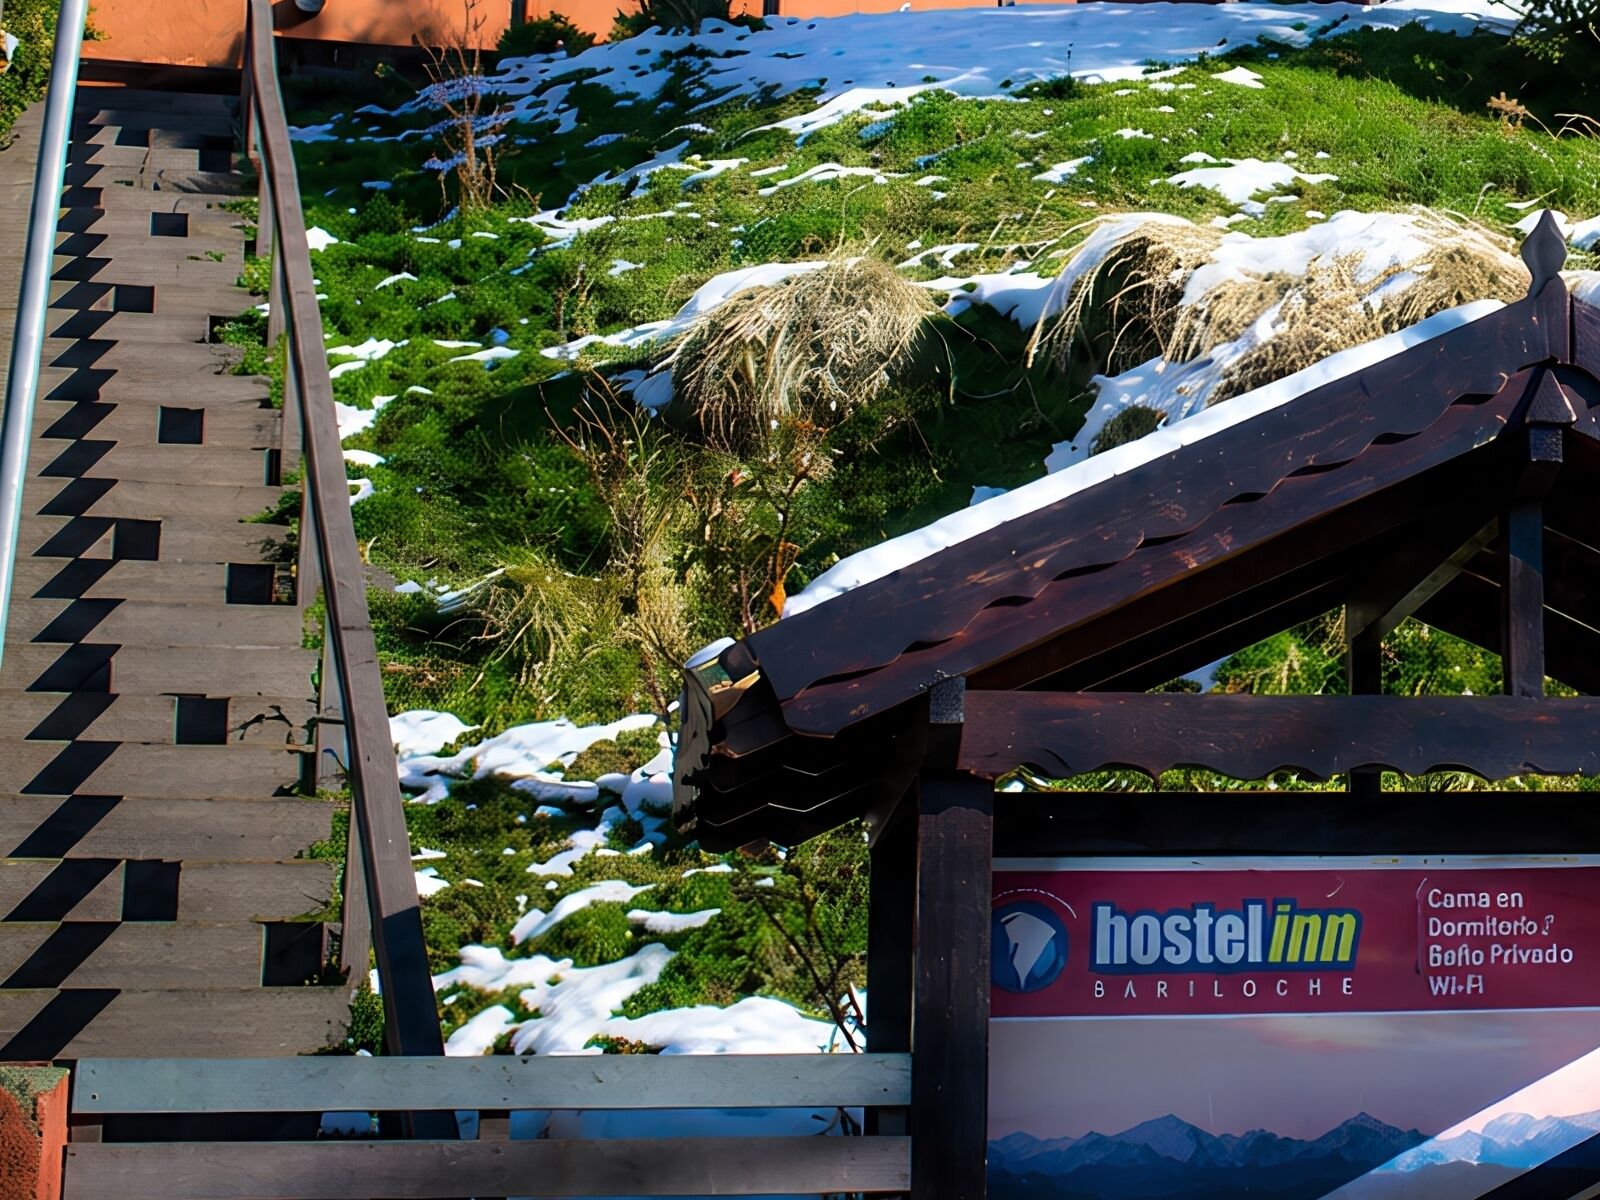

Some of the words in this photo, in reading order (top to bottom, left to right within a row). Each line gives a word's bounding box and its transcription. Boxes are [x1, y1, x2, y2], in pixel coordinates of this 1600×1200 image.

[1428, 888, 1491, 909] Cama
[1496, 891, 1524, 908] en
[1095, 903, 1263, 965] hostel
[1490, 943, 1574, 965] Privado
[1094, 977, 1353, 999] BARILOCHE
